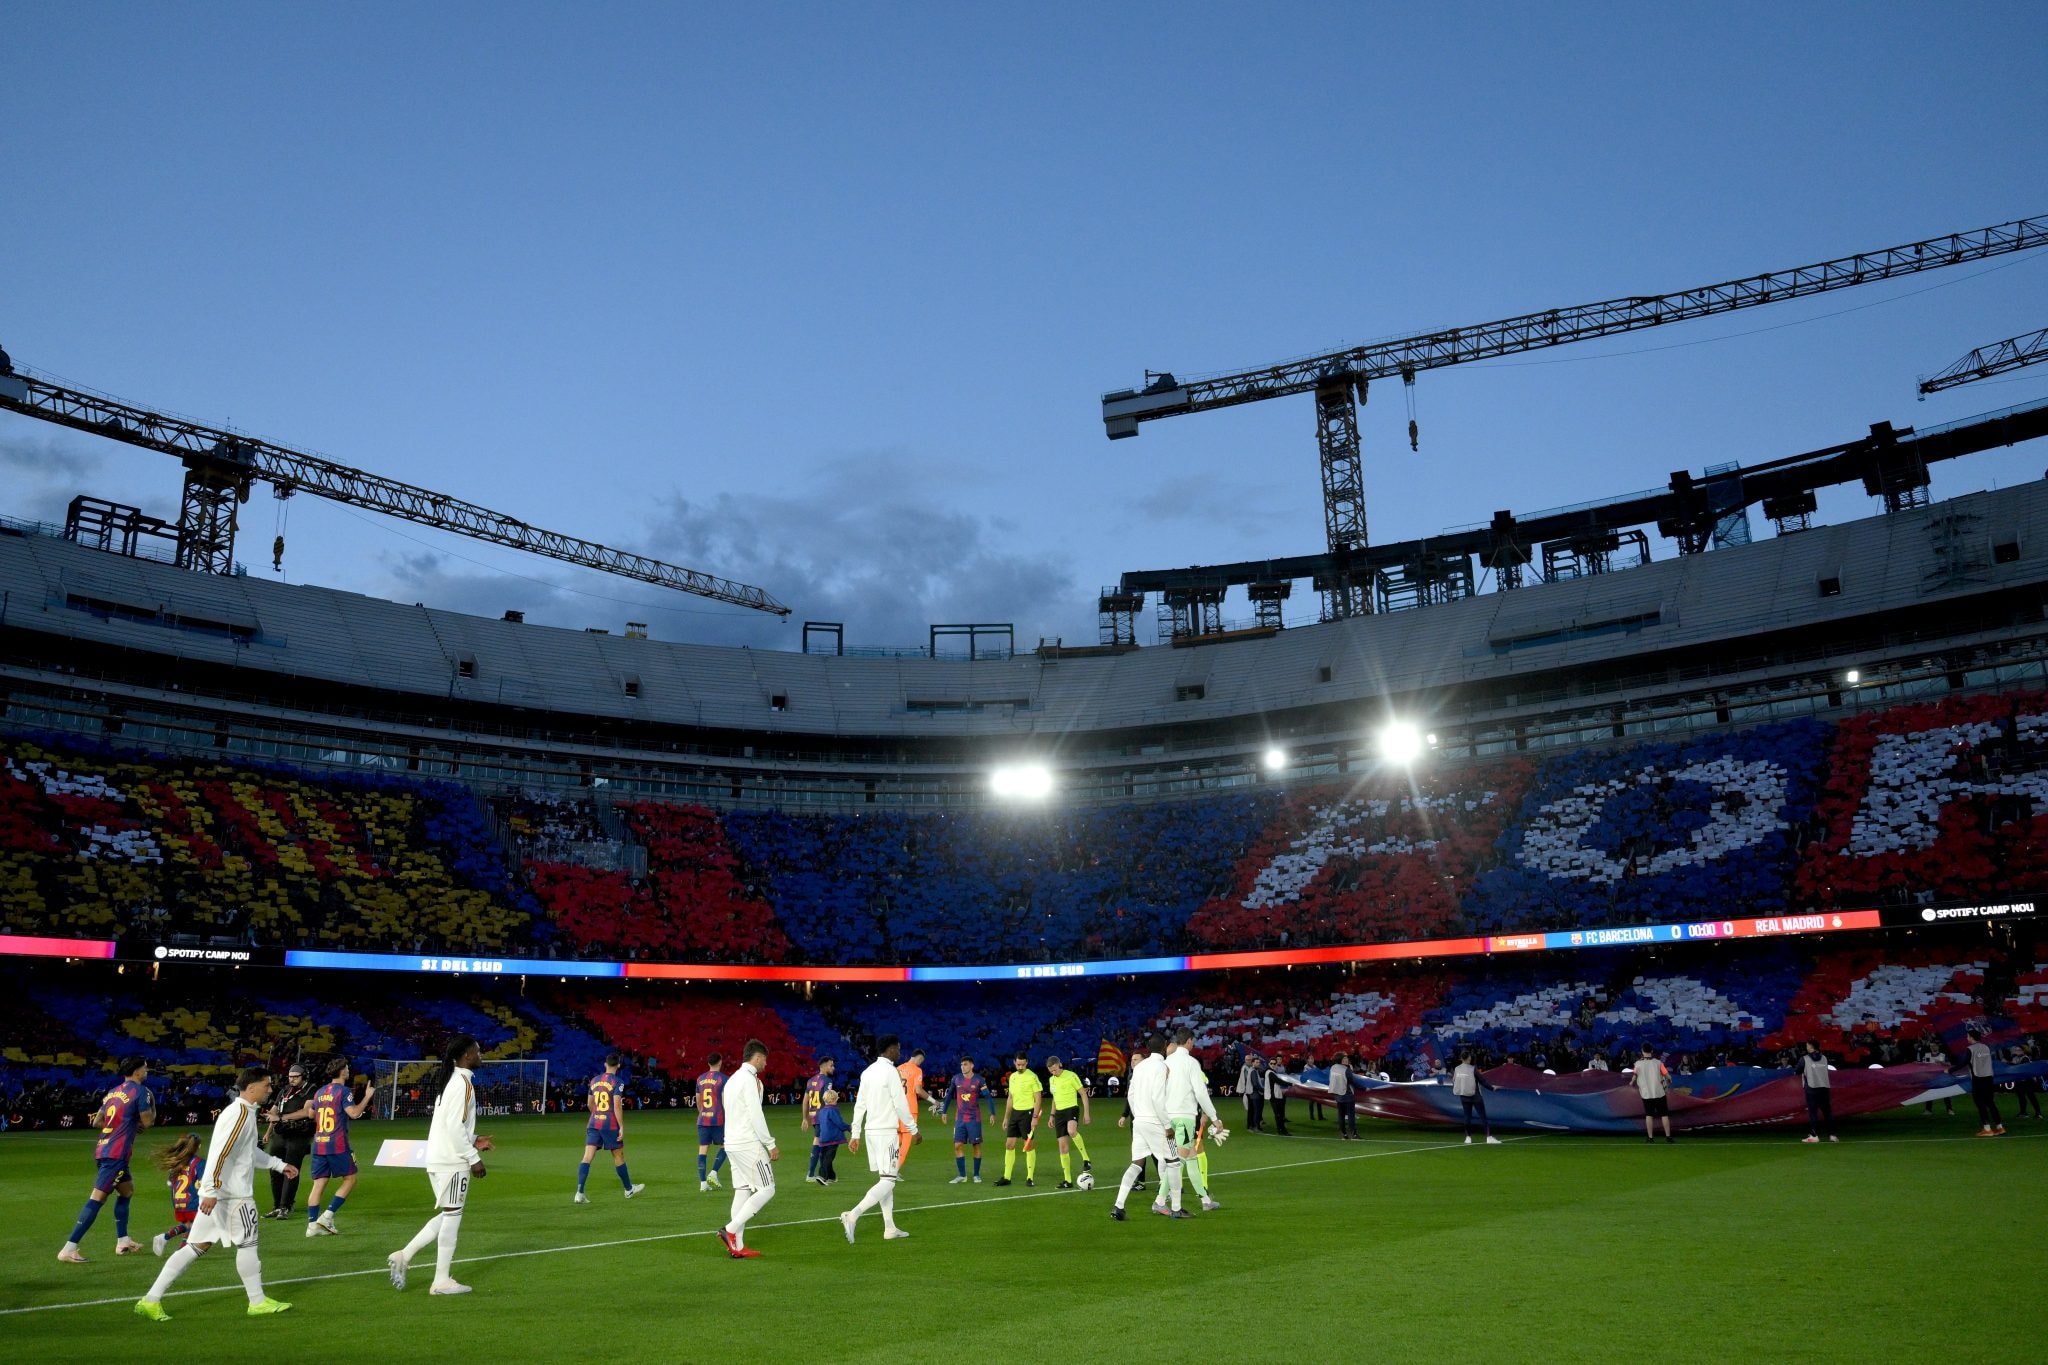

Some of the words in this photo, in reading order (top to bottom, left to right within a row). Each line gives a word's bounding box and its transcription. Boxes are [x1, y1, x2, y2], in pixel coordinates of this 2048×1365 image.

[1937, 907, 1978, 918] SPOTIFY
[1980, 904, 2010, 915] CAMP
[2011, 902, 2035, 913] NOU
[1671, 925, 1681, 939] 0
[1688, 923, 1716, 938] 00:00
[1723, 921, 1734, 936] 0
[1755, 919, 1782, 933] REAL
[1782, 916, 1825, 931] MADRID
[1586, 931, 1598, 945] FC
[1599, 927, 1654, 943] BARCELONA
[168, 948, 205, 958] SPOTIFY
[205, 950, 230, 959] CAMP
[231, 951, 250, 960] NOU
[421, 959, 438, 971] SI
[441, 959, 469, 972] DEL
[472, 961, 503, 973] SUD
[1017, 967, 1031, 978] SI
[1034, 966, 1057, 977] DEL
[1059, 965, 1084, 976] SUD
[593, 1090, 610, 1112] 18
[703, 1088, 713, 1109] 5
[476, 1105, 510, 1116] OTBALL
[317, 1106, 335, 1133] 16
[174, 1174, 190, 1200] 2
[460, 1177, 468, 1193] 6
